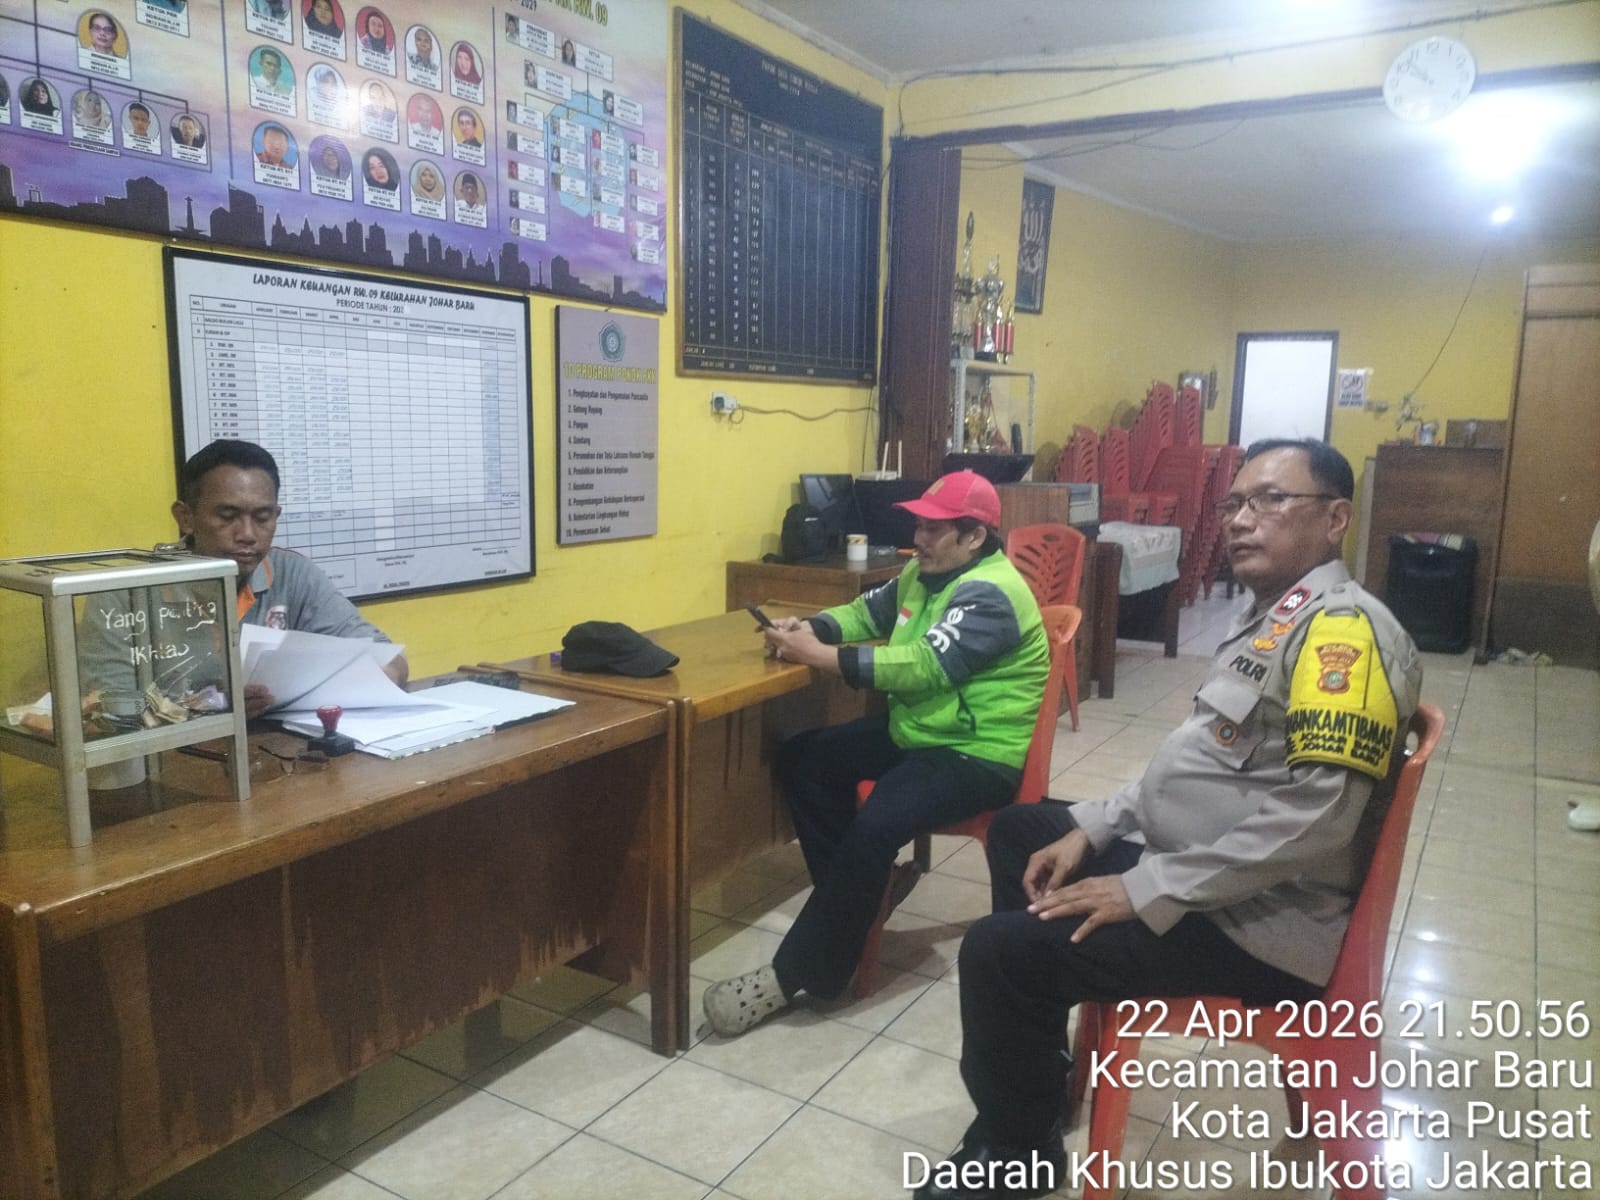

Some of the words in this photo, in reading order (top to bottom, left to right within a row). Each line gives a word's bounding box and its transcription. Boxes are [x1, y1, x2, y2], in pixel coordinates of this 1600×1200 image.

[252, 273, 297, 289] LAPORAN
[300, 279, 351, 296] KEUANGAN
[380, 290, 427, 305] KELURAHAN
[429, 296, 454, 310] JOHAR
[455, 299, 475, 311] BARU
[336, 298, 365, 310] PERIODE
[365, 302, 388, 313] TAHUN
[100, 608, 148, 636] Yang
[1229, 655, 1267, 683] POLRI
